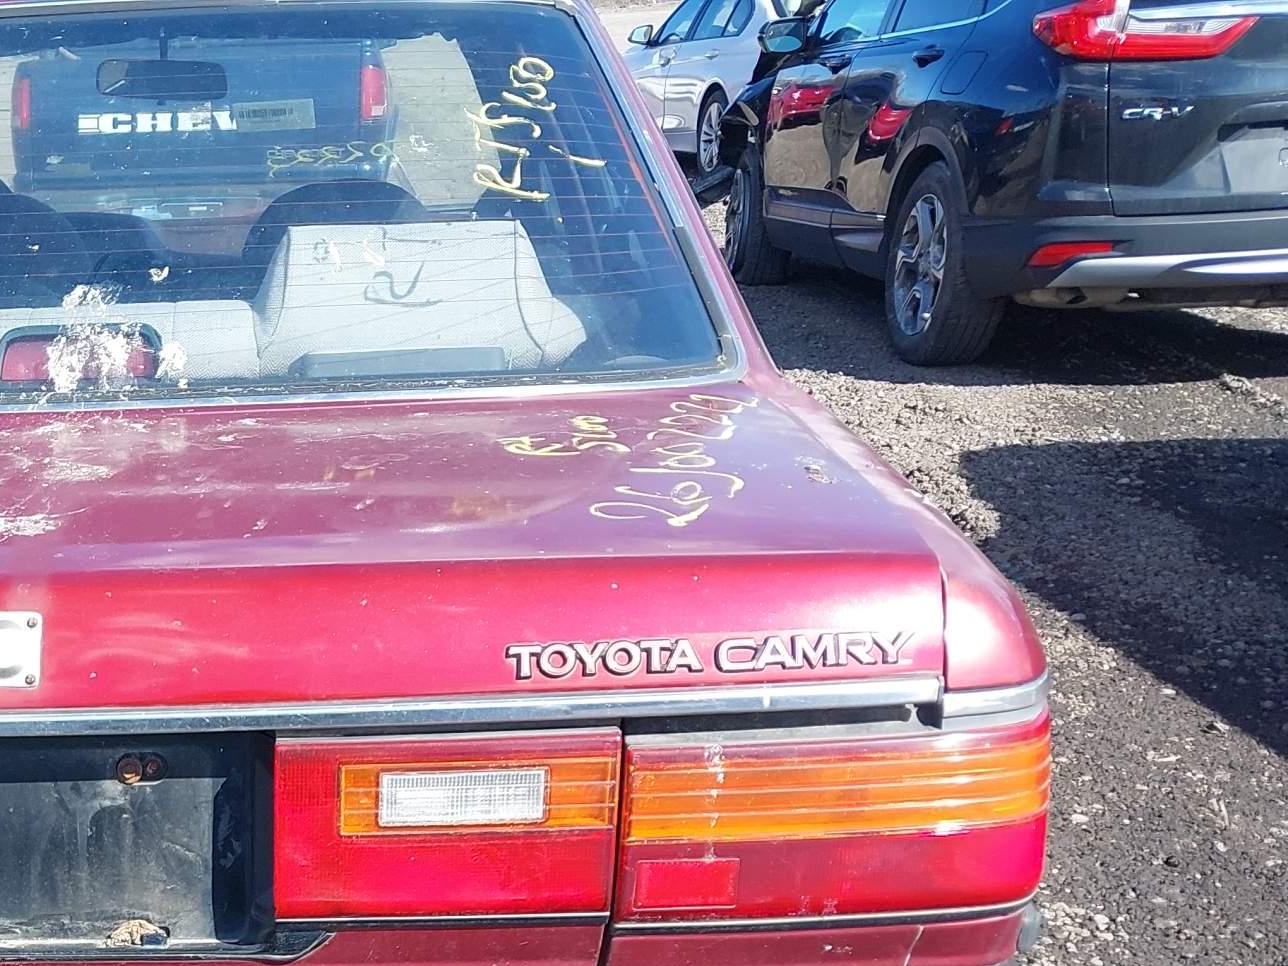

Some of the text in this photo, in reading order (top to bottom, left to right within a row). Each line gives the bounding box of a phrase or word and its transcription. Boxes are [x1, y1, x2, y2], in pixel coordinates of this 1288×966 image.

[1121, 105, 1195, 121] CR-V
[505, 630, 915, 681] TOYOTA CAMRY
